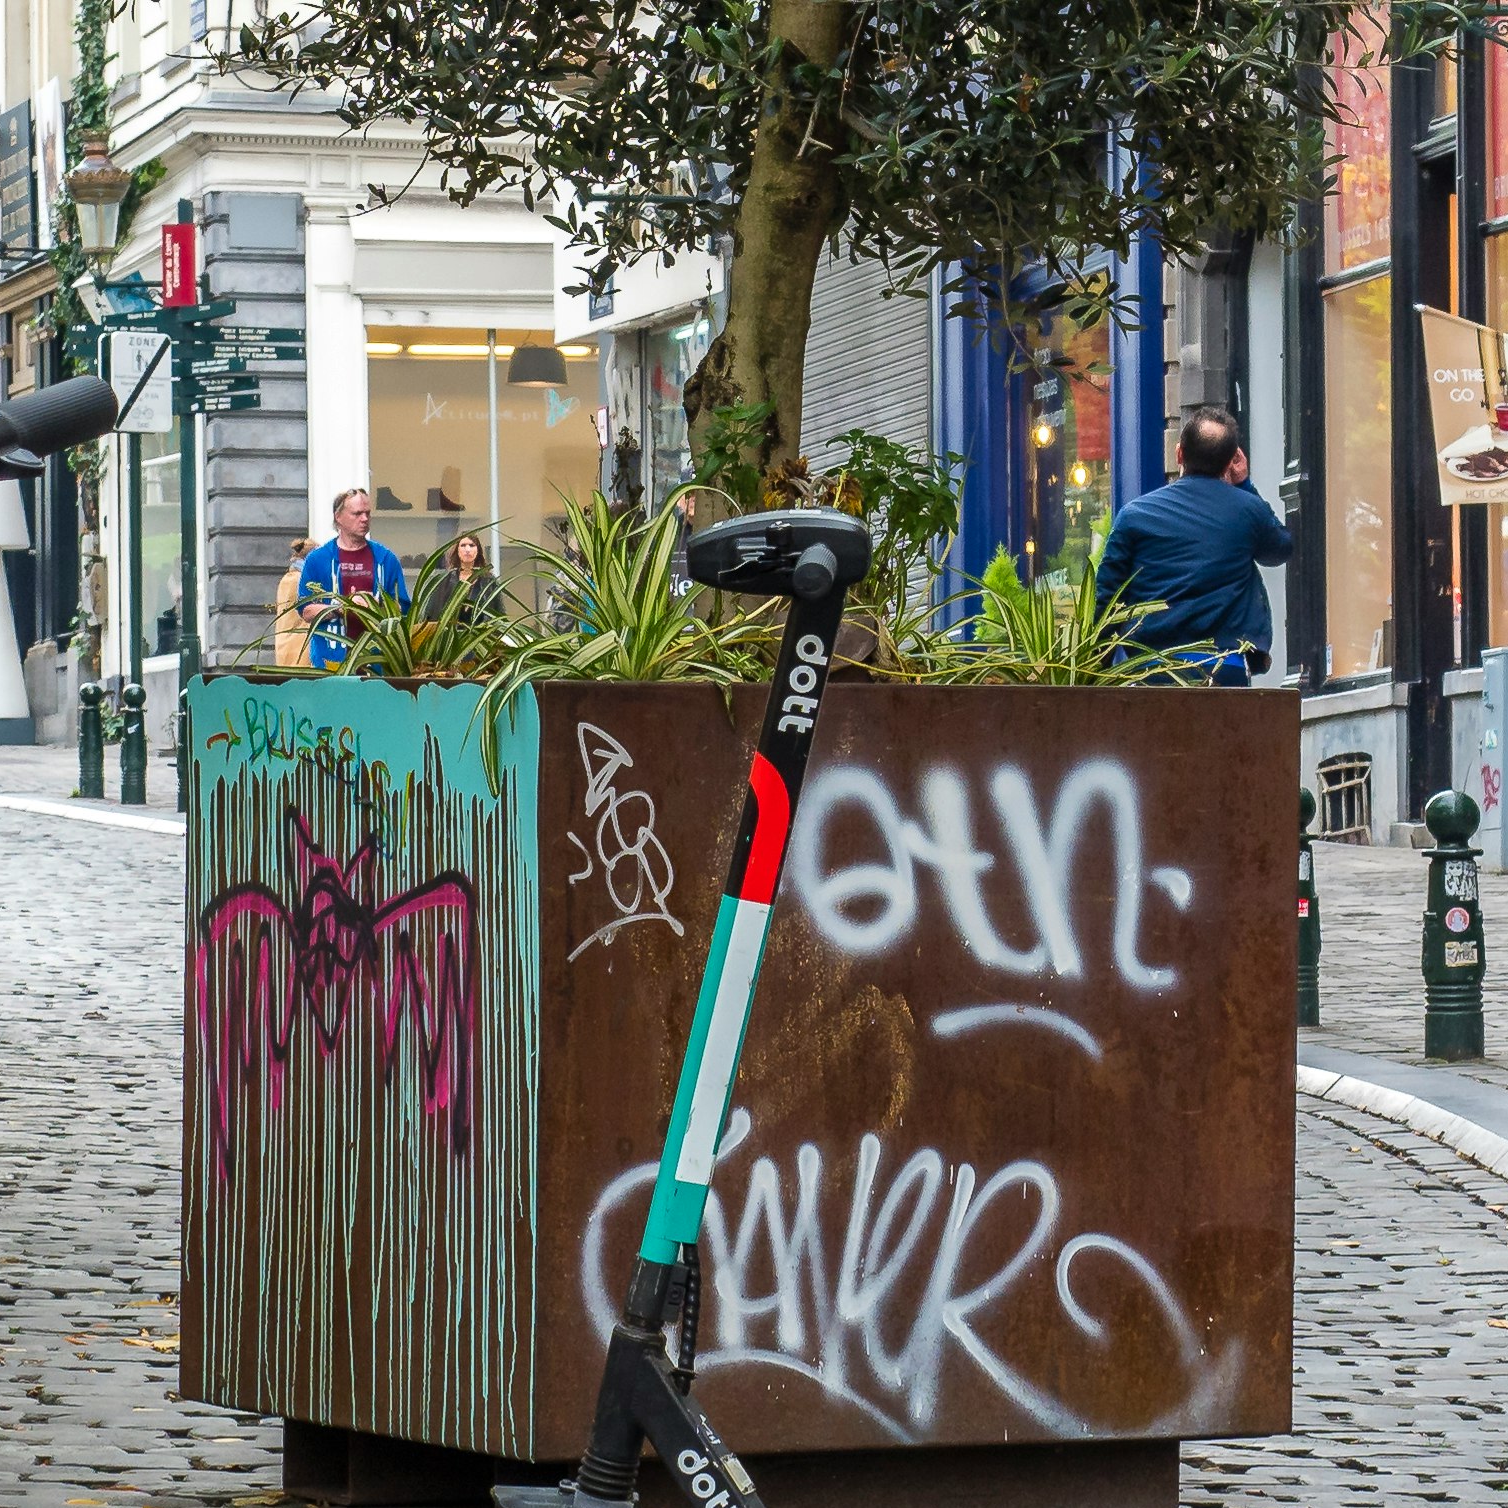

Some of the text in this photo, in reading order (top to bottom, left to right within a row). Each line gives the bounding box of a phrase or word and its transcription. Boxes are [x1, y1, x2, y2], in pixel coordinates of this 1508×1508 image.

[128, 336, 157, 347] ZONE
[1433, 368, 1486, 383] ON THE
[1449, 388, 1475, 403] GO
[1465, 488, 1485, 499] HOT
[777, 634, 828, 734] dott
